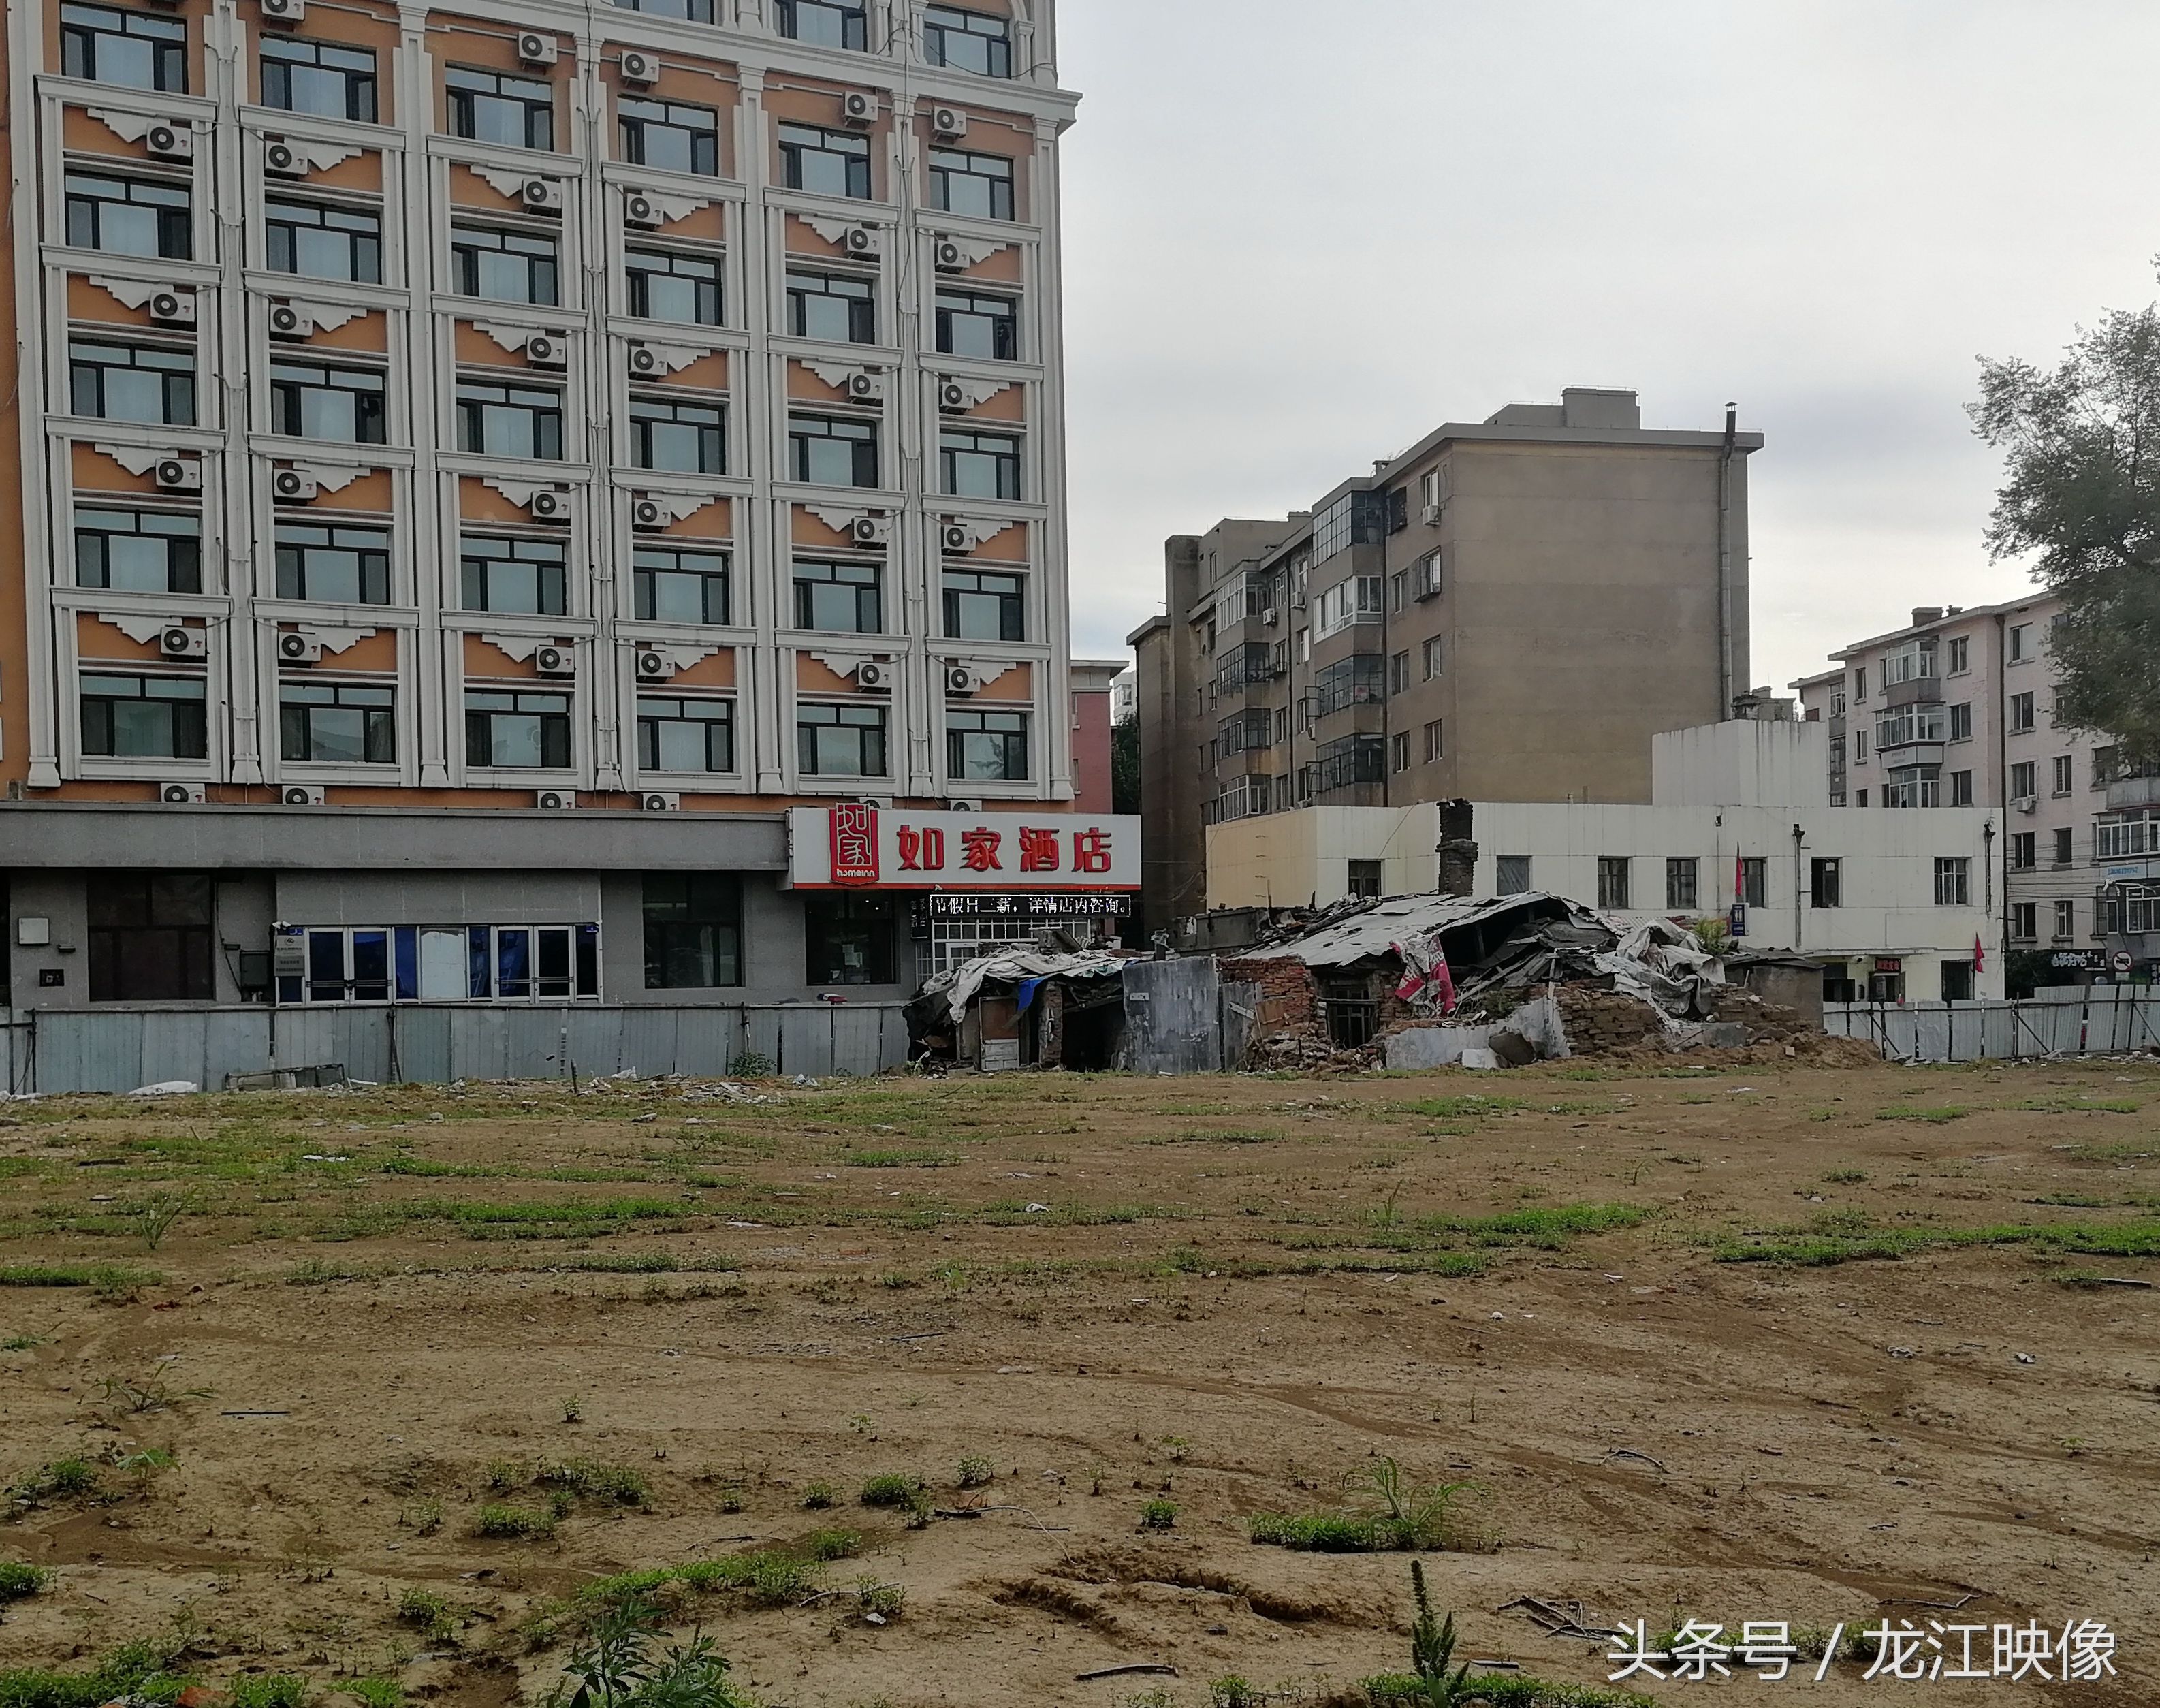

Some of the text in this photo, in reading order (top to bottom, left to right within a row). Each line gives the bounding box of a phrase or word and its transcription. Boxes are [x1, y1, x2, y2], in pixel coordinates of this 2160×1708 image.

[836, 803, 872, 866] 如家
[896, 824, 1112, 872] 如家酒店
